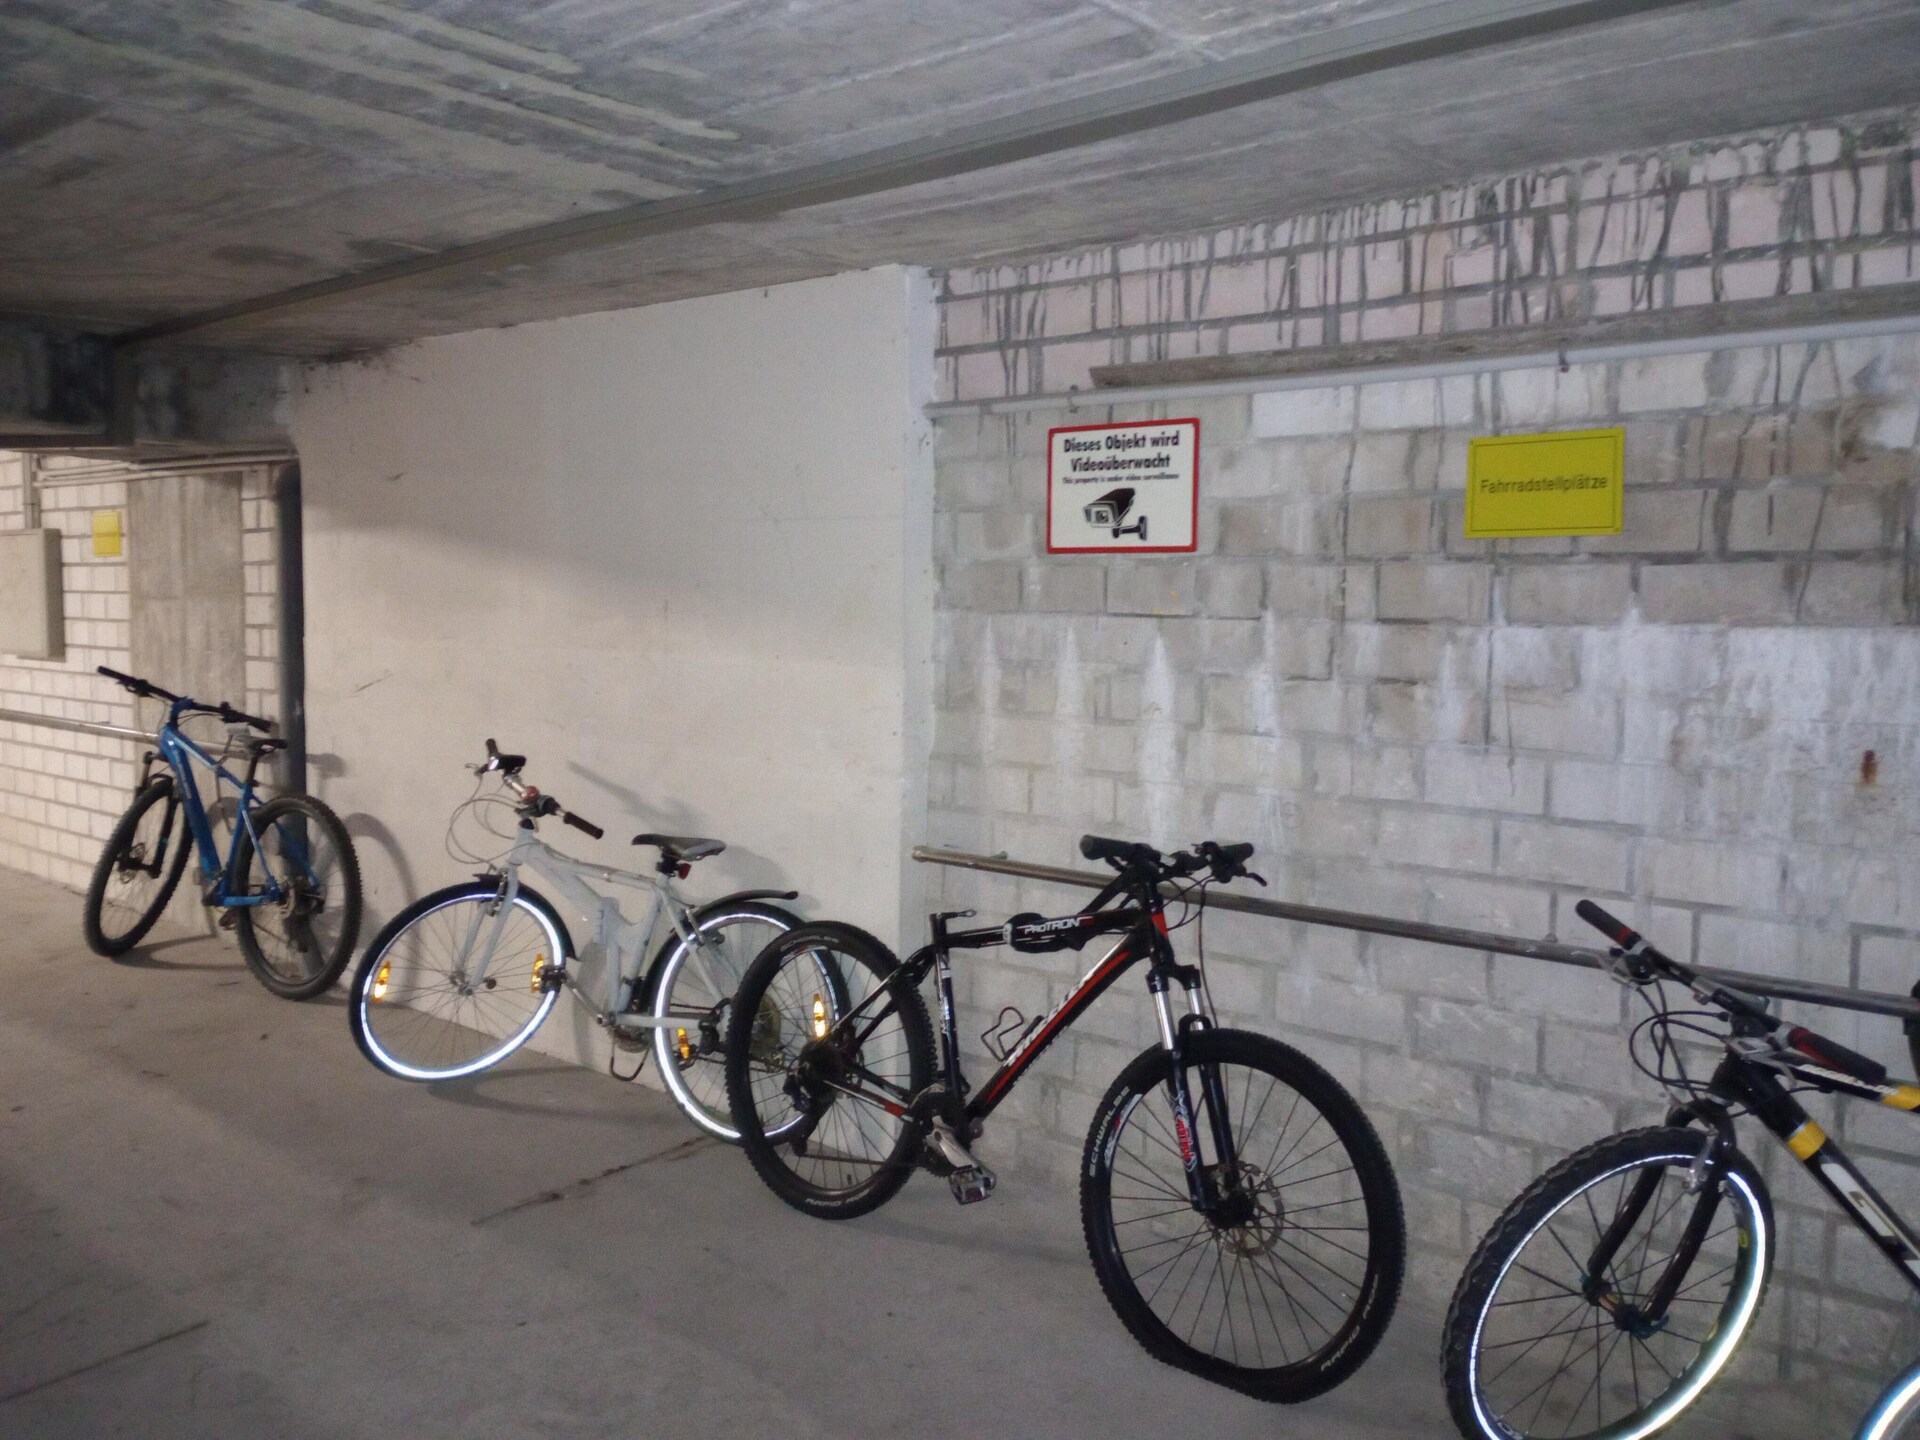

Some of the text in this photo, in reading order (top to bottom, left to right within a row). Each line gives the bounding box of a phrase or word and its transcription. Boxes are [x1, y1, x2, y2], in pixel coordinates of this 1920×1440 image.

[1064, 430, 1180, 453] Dieses Objekt wird
[1070, 452, 1171, 472] Videoüberwacht
[1480, 474, 1609, 494] Fahrradstellplätze
[1089, 1086, 1130, 1178] SCHWALBE
